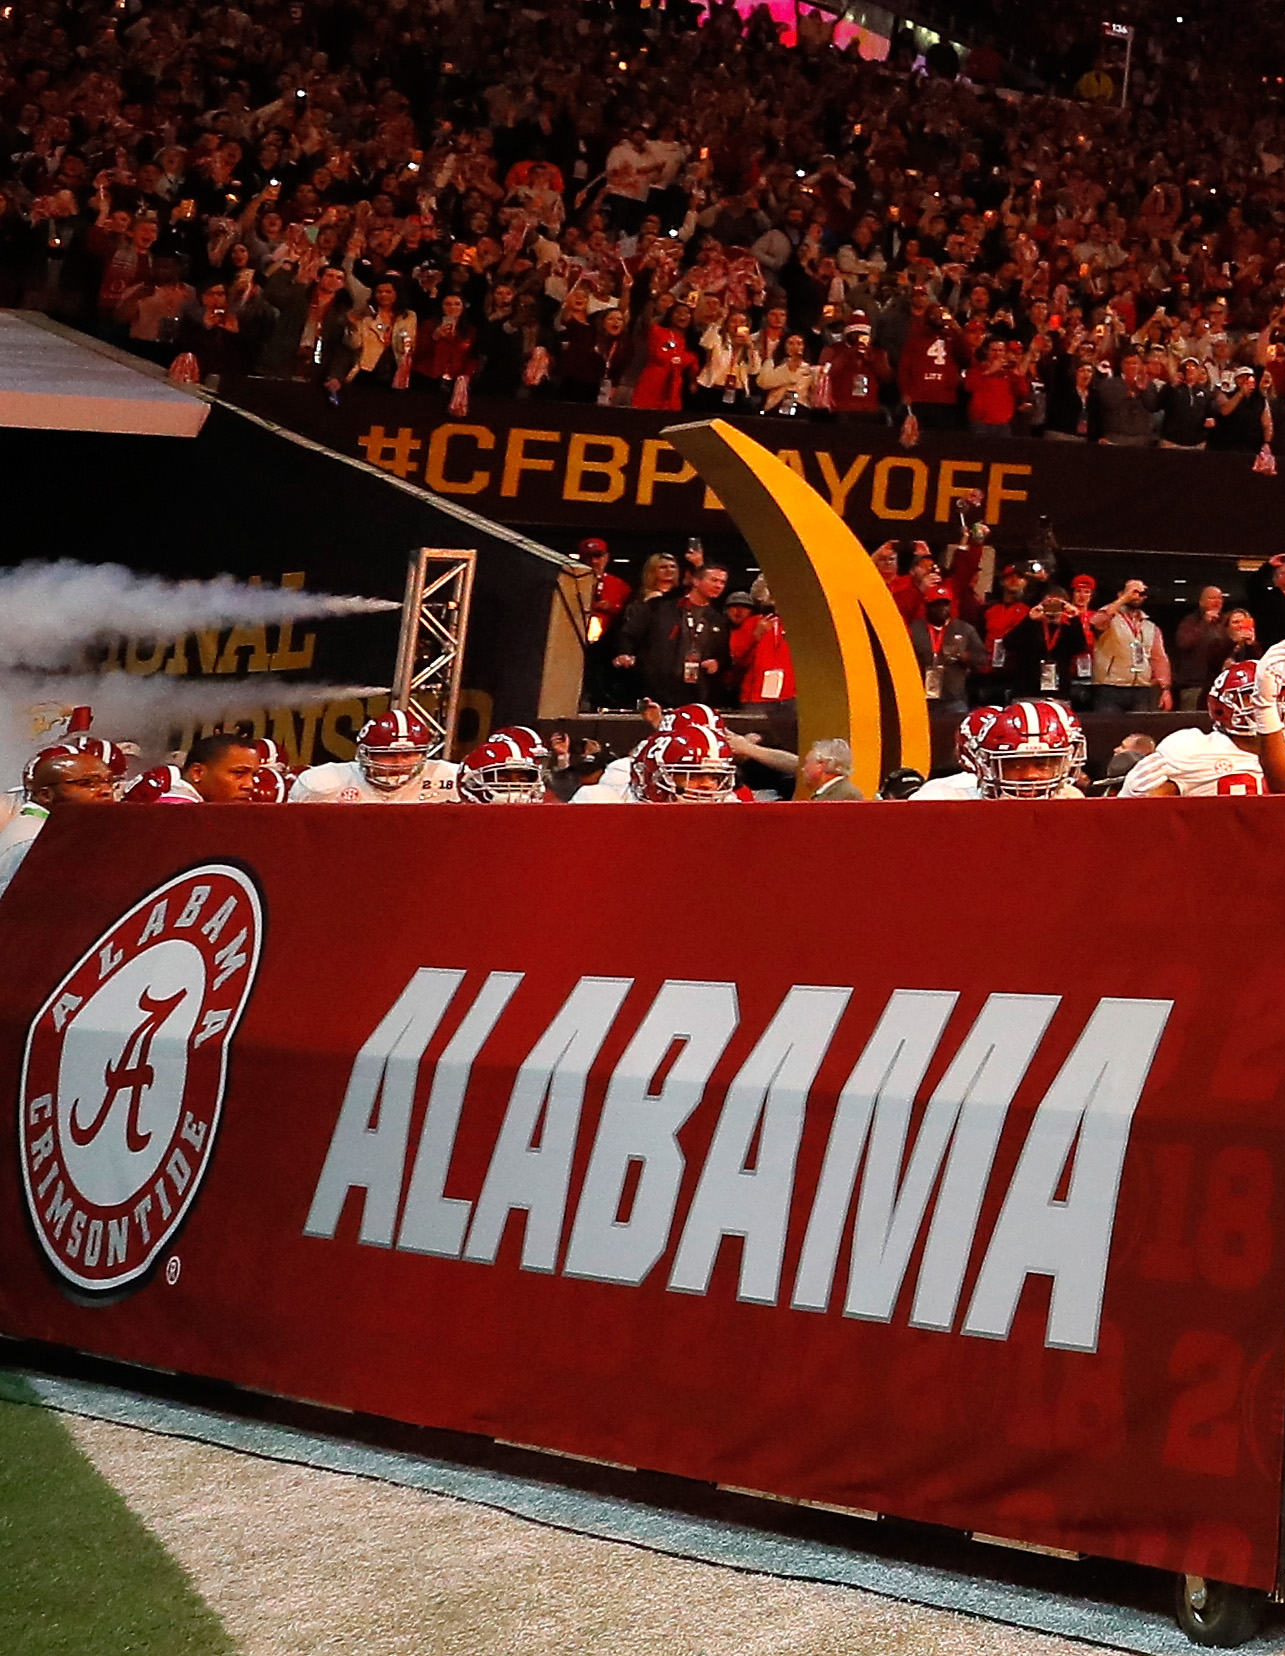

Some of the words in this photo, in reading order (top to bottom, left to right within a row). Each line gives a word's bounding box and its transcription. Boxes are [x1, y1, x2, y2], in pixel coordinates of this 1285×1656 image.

[927, 339, 947, 365] 4
[358, 423, 1032, 526] #CFBPYOFF
[51, 885, 249, 1049] ALABAMA
[68, 984, 188, 1153] A
[29, 1092, 129, 1268] CRIMSON
[133, 1111, 208, 1245] TIDE
[303, 966, 1175, 1353] ALABAMA
